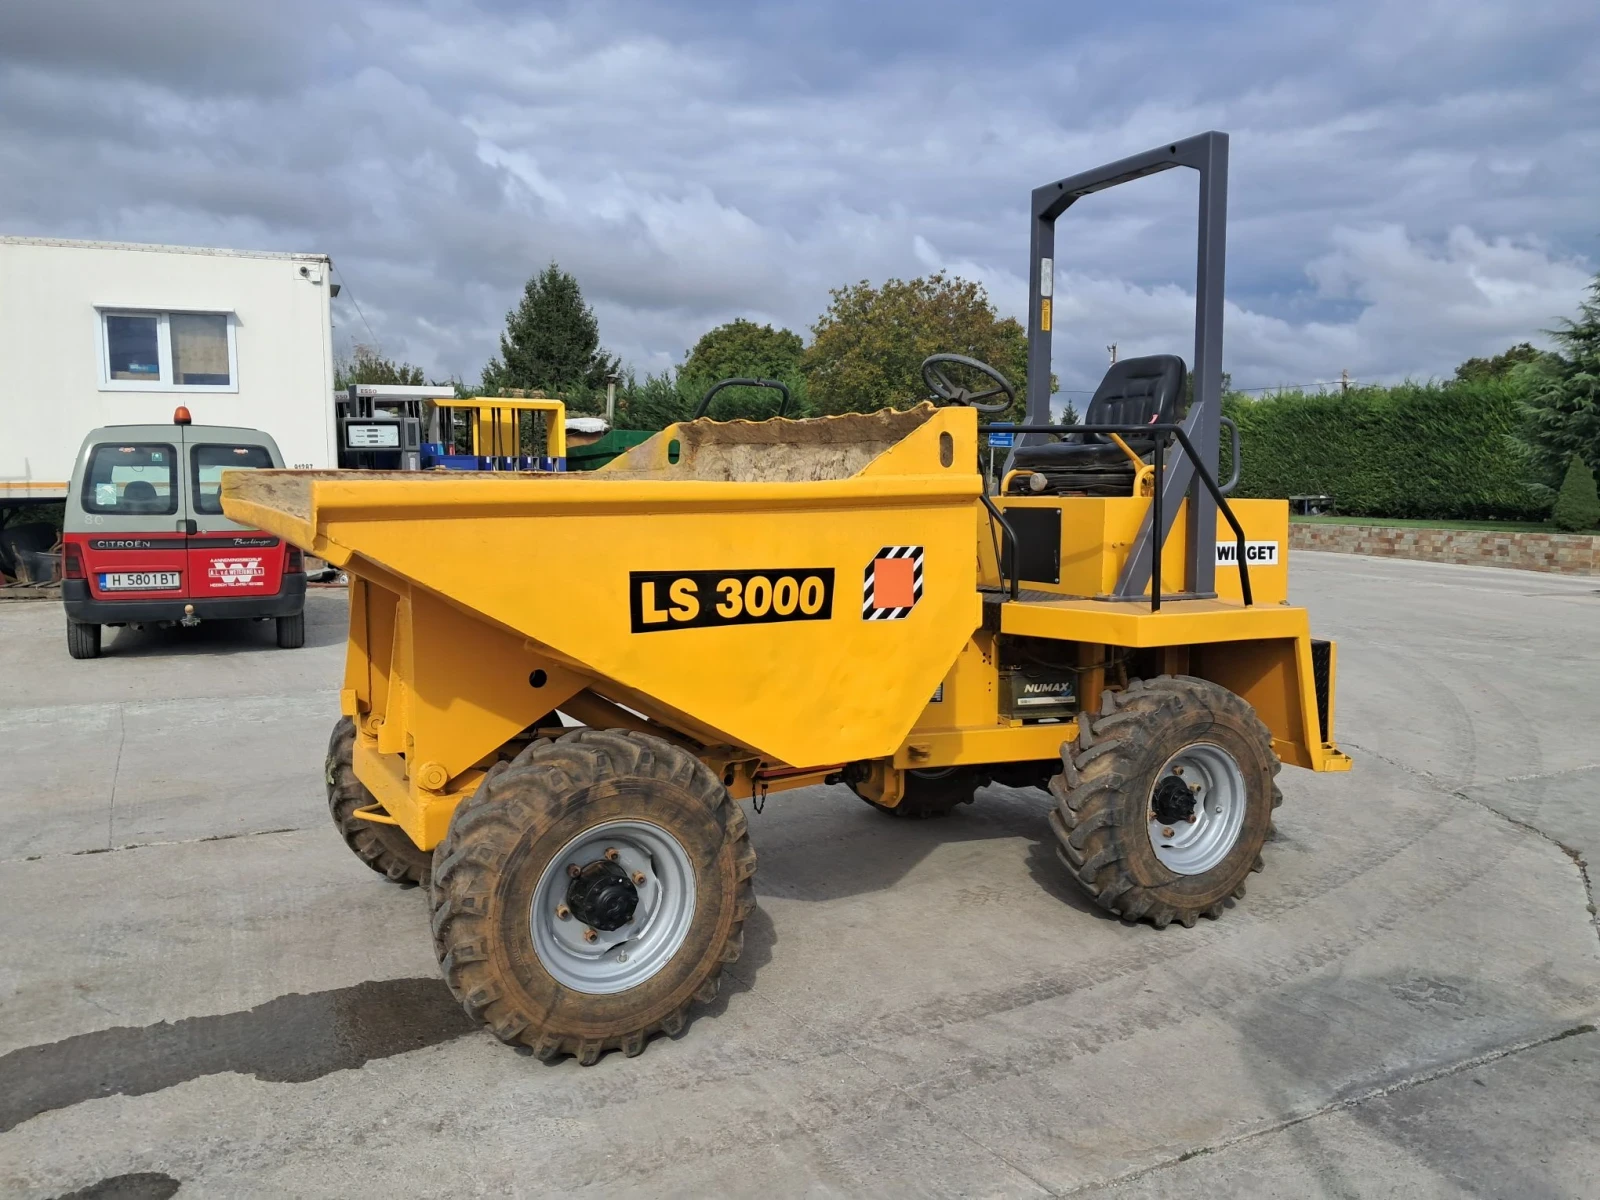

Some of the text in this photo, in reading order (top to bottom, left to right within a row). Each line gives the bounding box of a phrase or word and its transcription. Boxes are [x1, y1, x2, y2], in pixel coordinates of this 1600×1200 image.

[233, 538, 271, 546] Berlingo
[1216, 545, 1276, 561] WIGET
[112, 574, 121, 586] H
[641, 575, 825, 624] LS 3000
[1024, 682, 1070, 693] NUMAX
